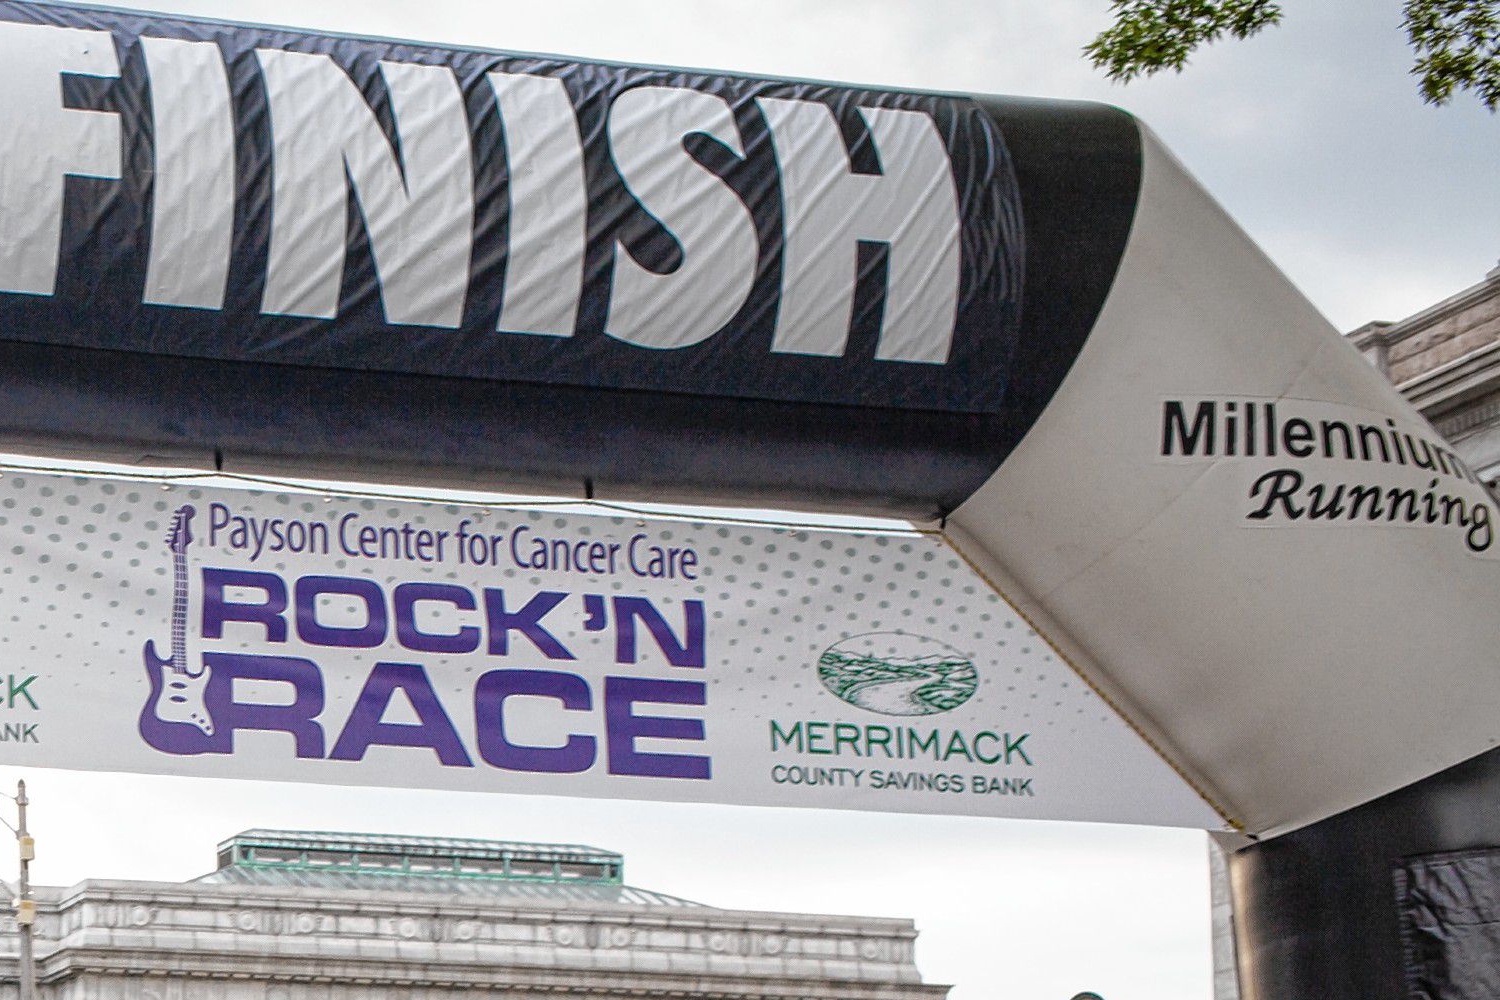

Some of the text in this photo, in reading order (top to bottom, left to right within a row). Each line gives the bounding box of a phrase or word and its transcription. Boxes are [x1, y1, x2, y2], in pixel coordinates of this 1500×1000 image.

[209, 502, 699, 580] Payson Center for Cancer Care
[1245, 468, 1493, 552] Running
[200, 566, 707, 669] ROCK'N
[200, 651, 712, 780] RACE
[770, 719, 1034, 766] MERRIMACK
[771, 764, 1034, 796] COUNTY SAVINGS BANK
